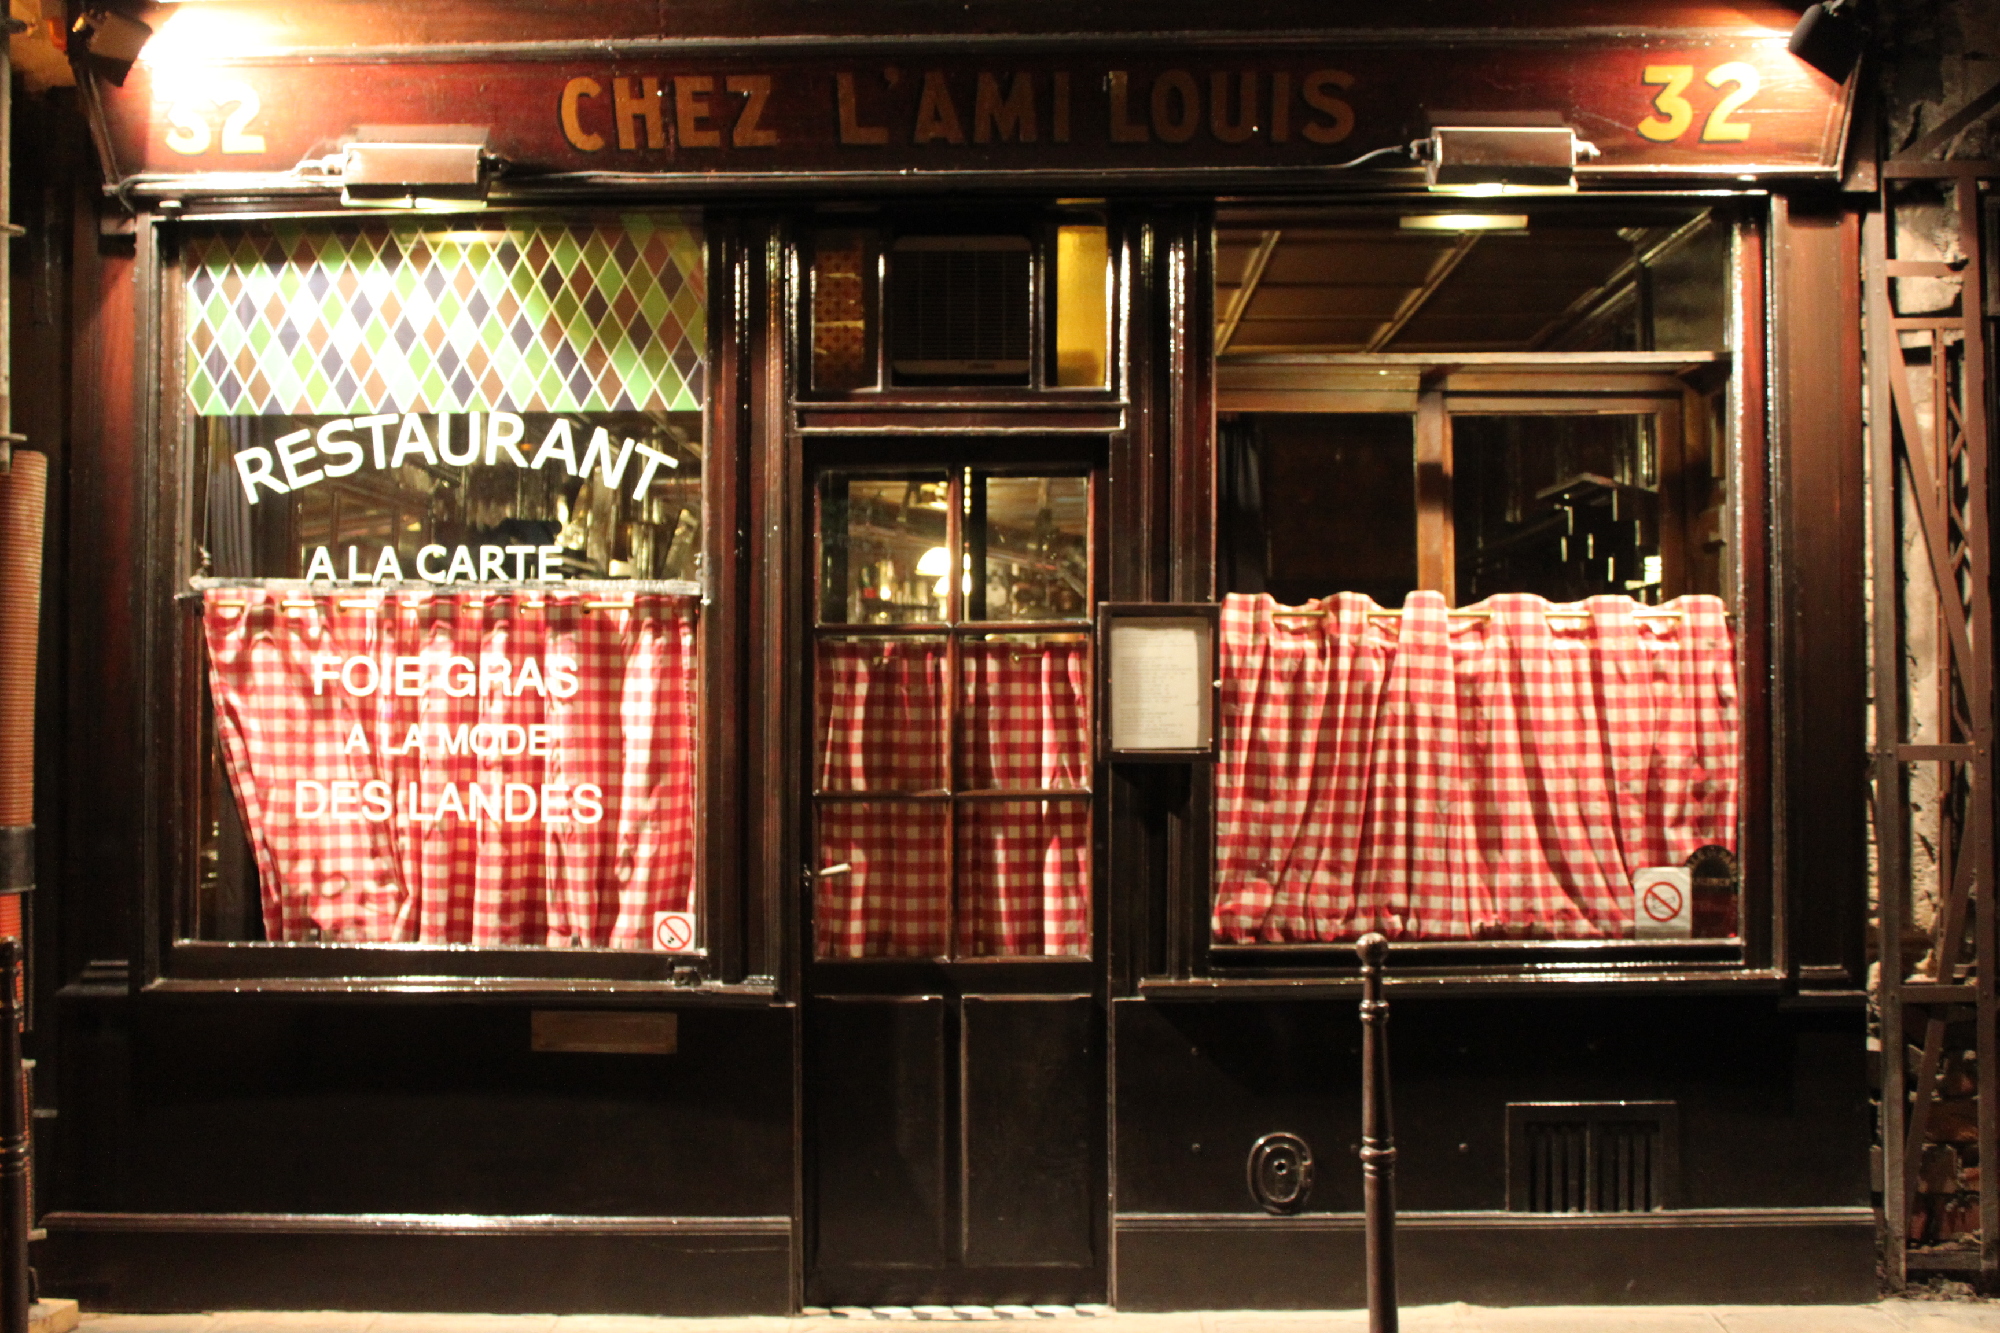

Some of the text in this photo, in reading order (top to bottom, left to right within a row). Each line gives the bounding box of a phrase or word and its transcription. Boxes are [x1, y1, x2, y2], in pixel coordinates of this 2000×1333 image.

[165, 80, 267, 156] 32
[558, 69, 1355, 153] CHEZ L'AMI LOUIS
[1636, 61, 1761, 142] 32
[233, 411, 679, 505] RESTAURANT
[305, 544, 564, 584] A LA CARTE
[311, 655, 579, 698] FOIE GRAS
[344, 723, 551, 756] A LA MODE
[295, 780, 604, 824] DES LANDES
